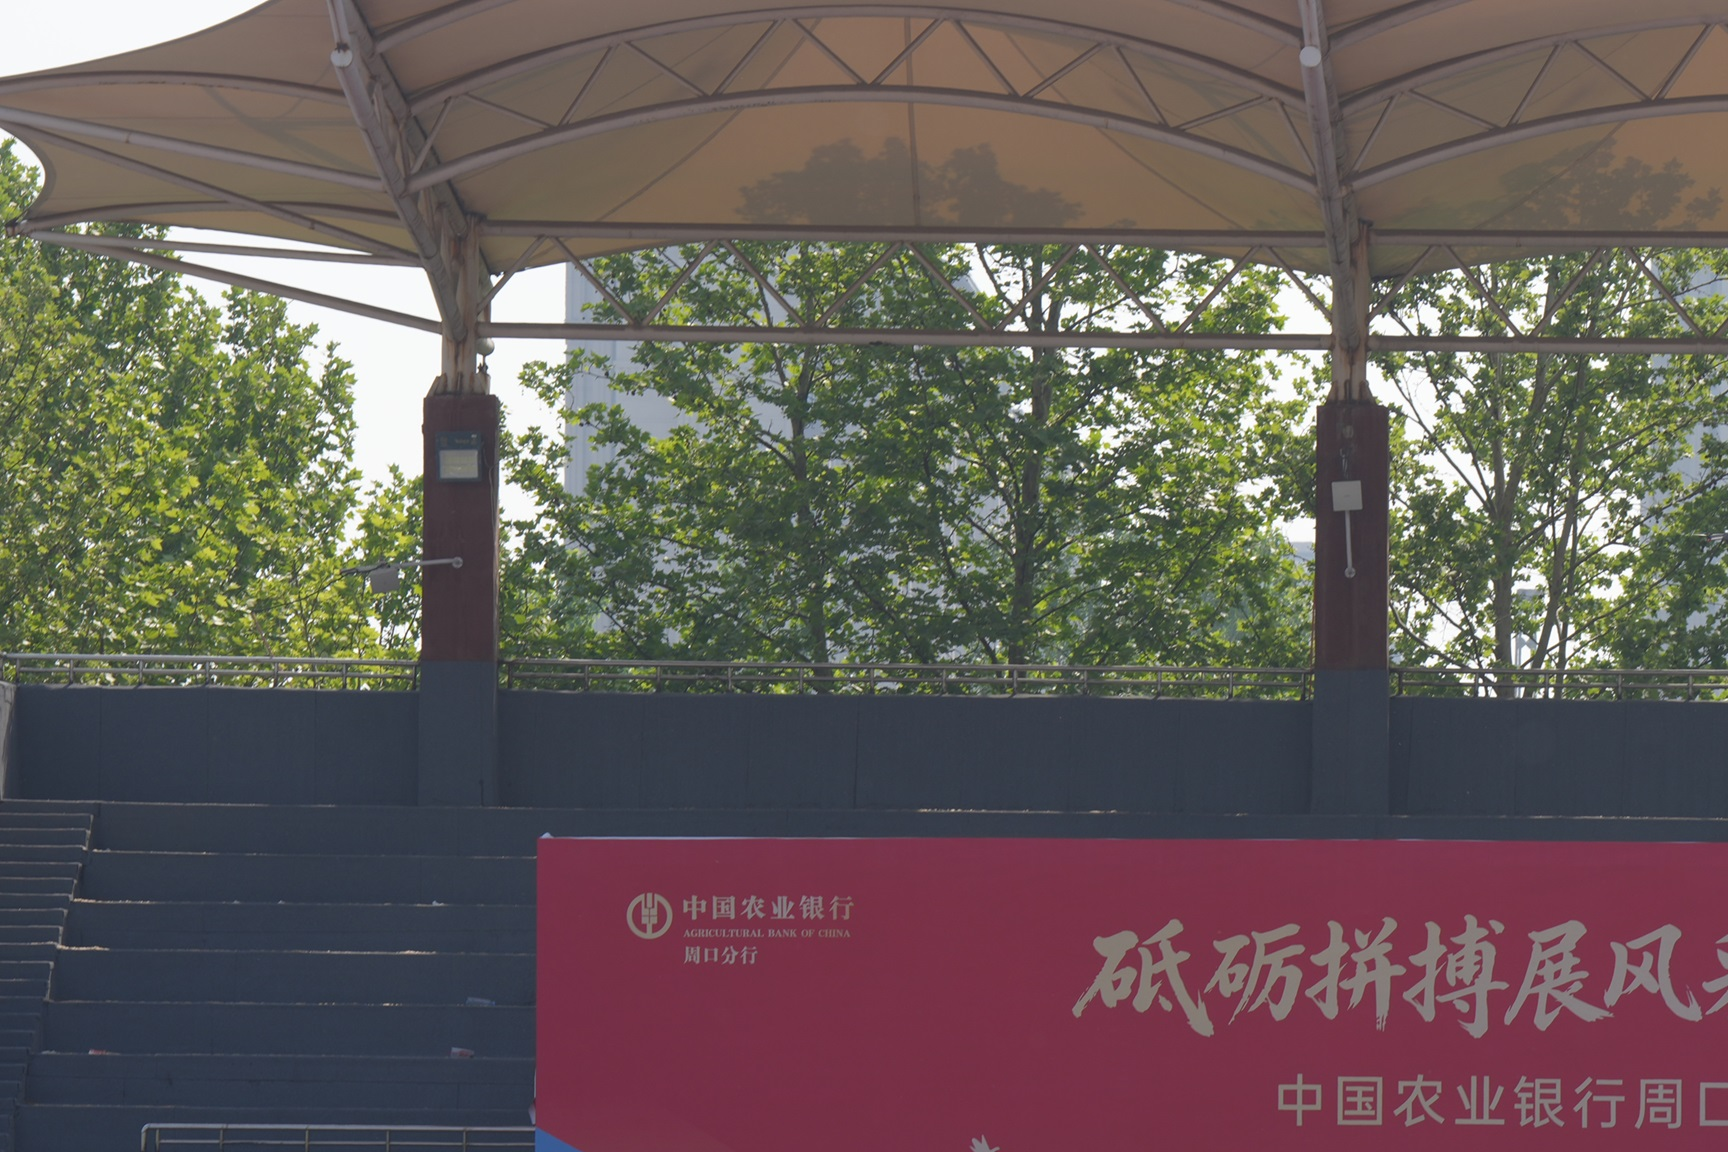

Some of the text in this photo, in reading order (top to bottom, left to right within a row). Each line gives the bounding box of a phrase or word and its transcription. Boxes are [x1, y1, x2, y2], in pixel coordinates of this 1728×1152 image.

[683, 895, 854, 921] 中国农业银行
[683, 929, 850, 938] AGRICULTURAL BANK OF CHINA
[684, 946, 758, 965] 周口分行
